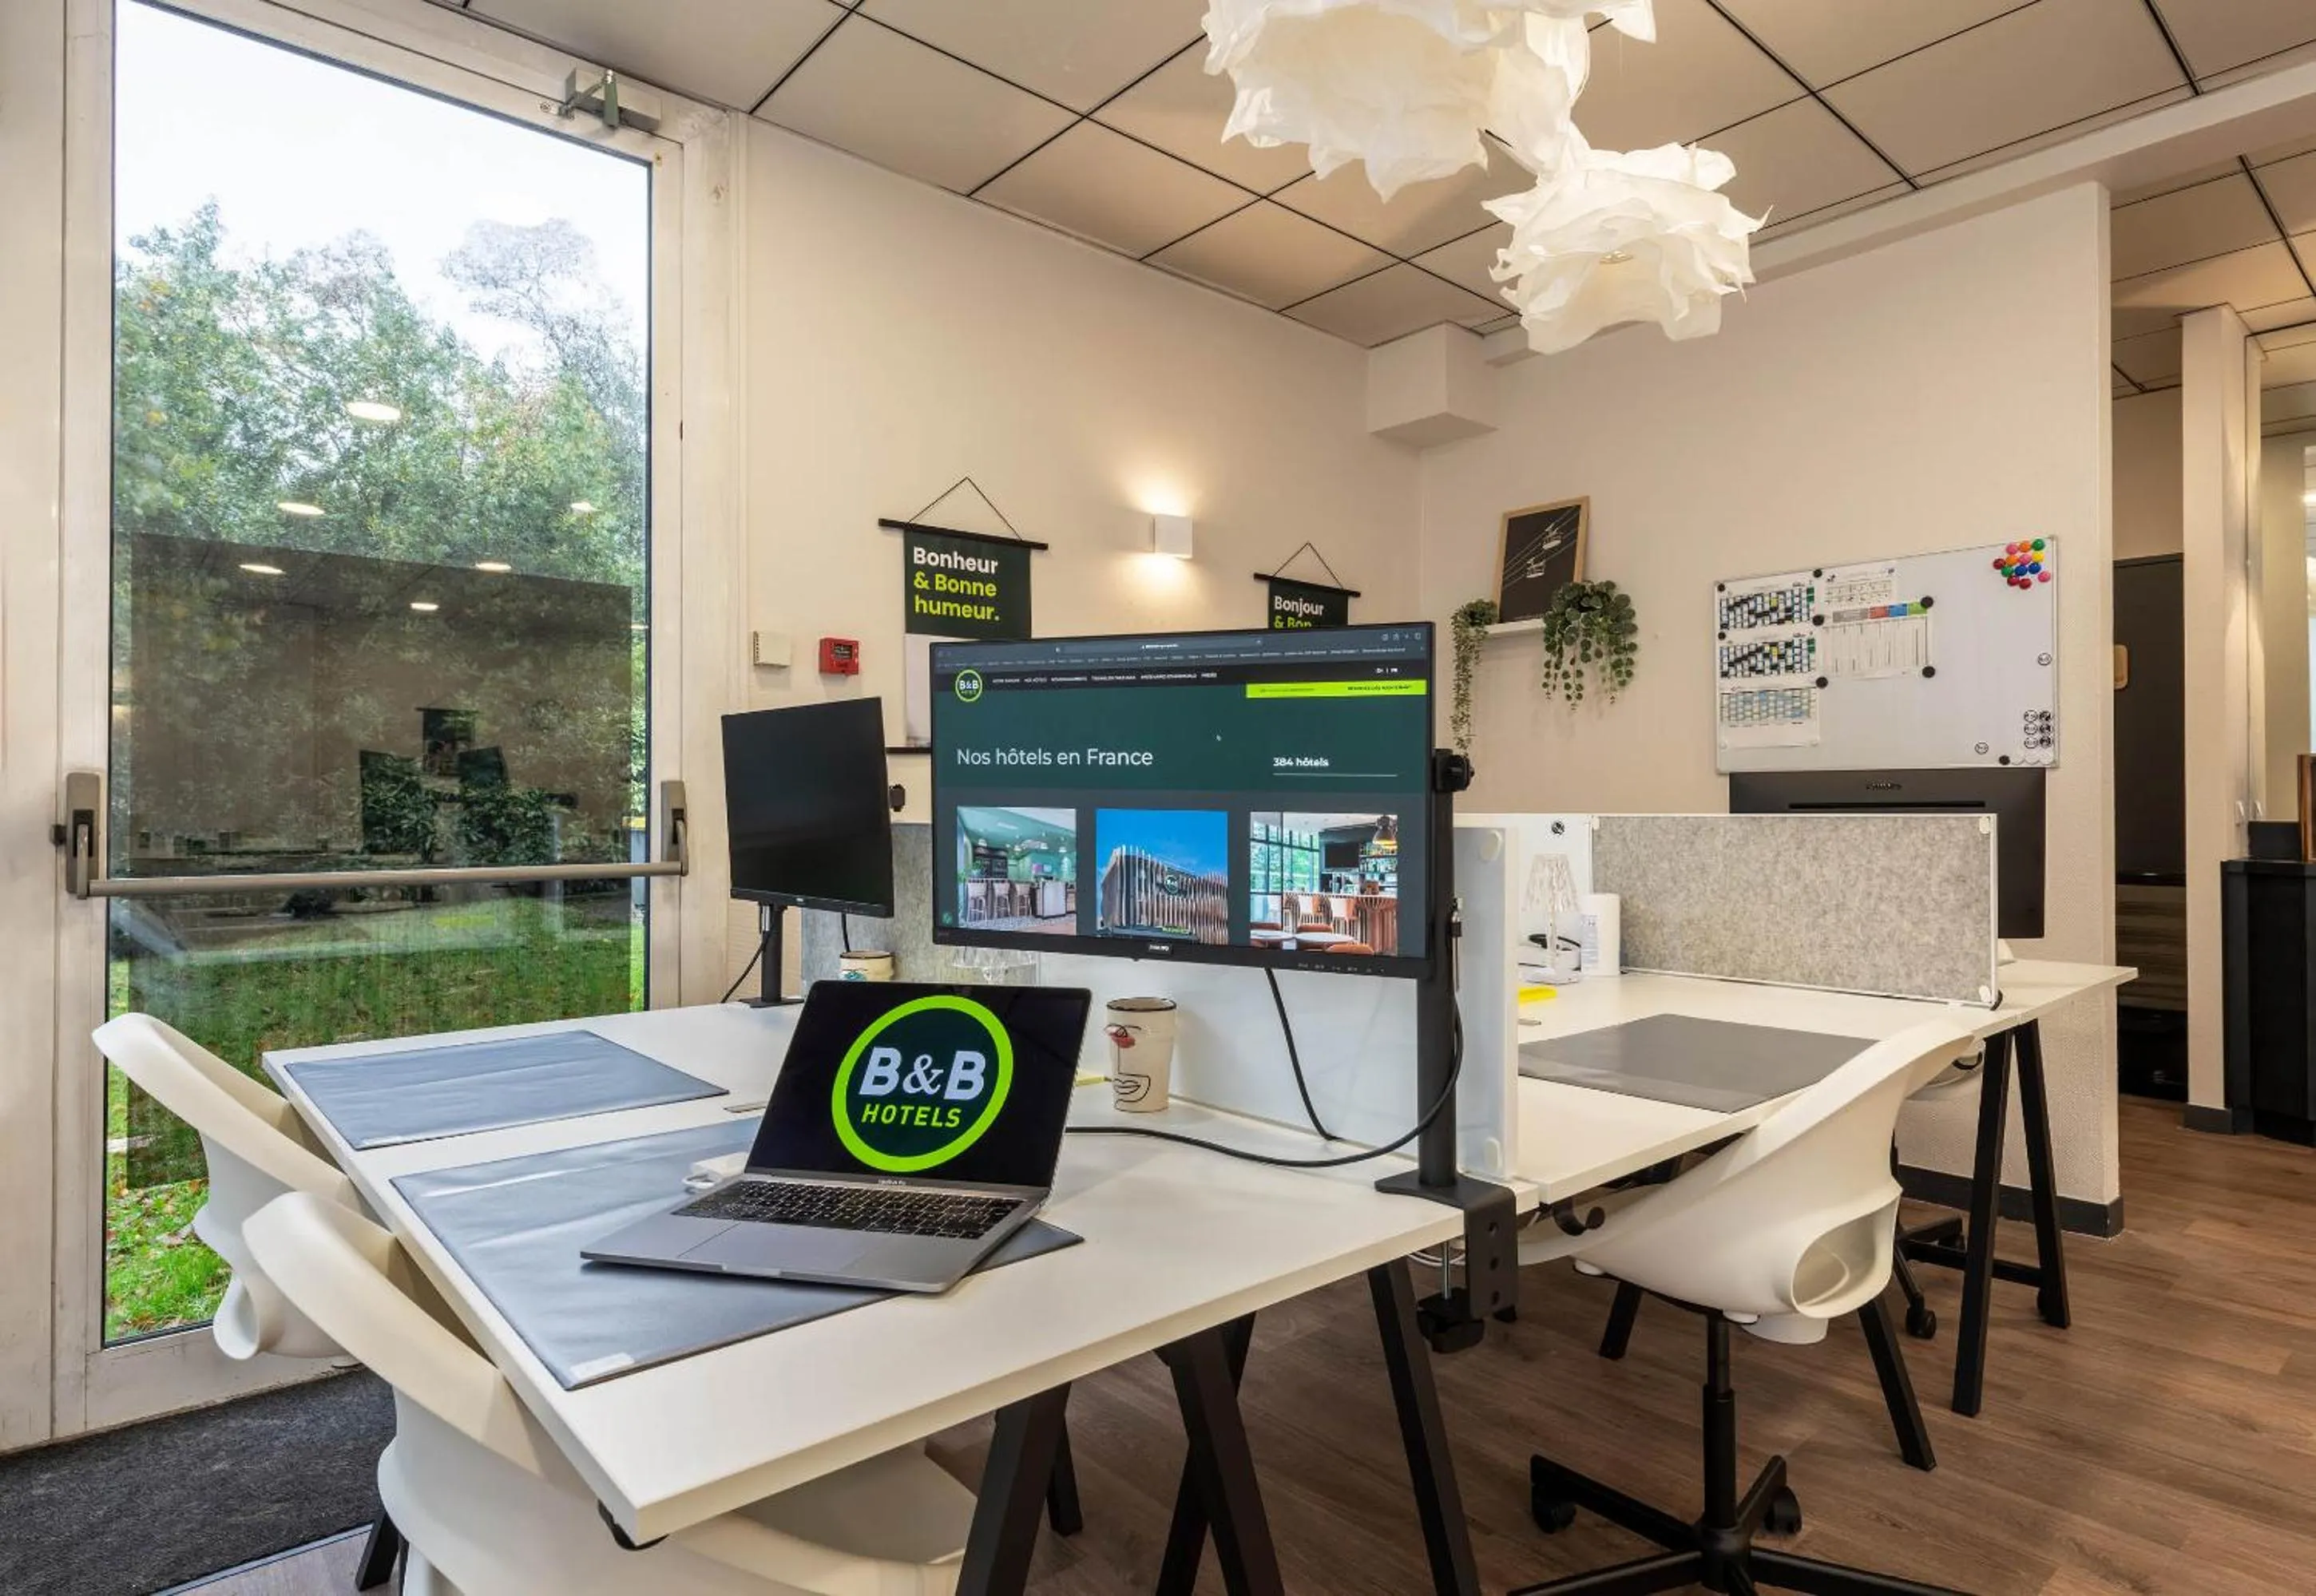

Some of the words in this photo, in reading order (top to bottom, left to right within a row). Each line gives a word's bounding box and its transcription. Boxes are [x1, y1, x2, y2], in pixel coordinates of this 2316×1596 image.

[914, 546, 998, 574] Bonheur
[914, 571, 930, 590] &
[935, 573, 997, 597] Bonne
[914, 595, 1000, 621] humeur.
[1275, 596, 1323, 617] Bonjour
[1275, 616, 1284, 628] &
[960, 680, 979, 690] B&B
[958, 748, 990, 765] Nos
[996, 748, 1052, 765] hôtels
[1057, 752, 1081, 765] en
[1087, 748, 1153, 765] France
[1273, 757, 1294, 766] 384
[1295, 757, 1329, 766] hôtels
[859, 1046, 986, 1100] B&B
[861, 1103, 962, 1127] HOTELS
